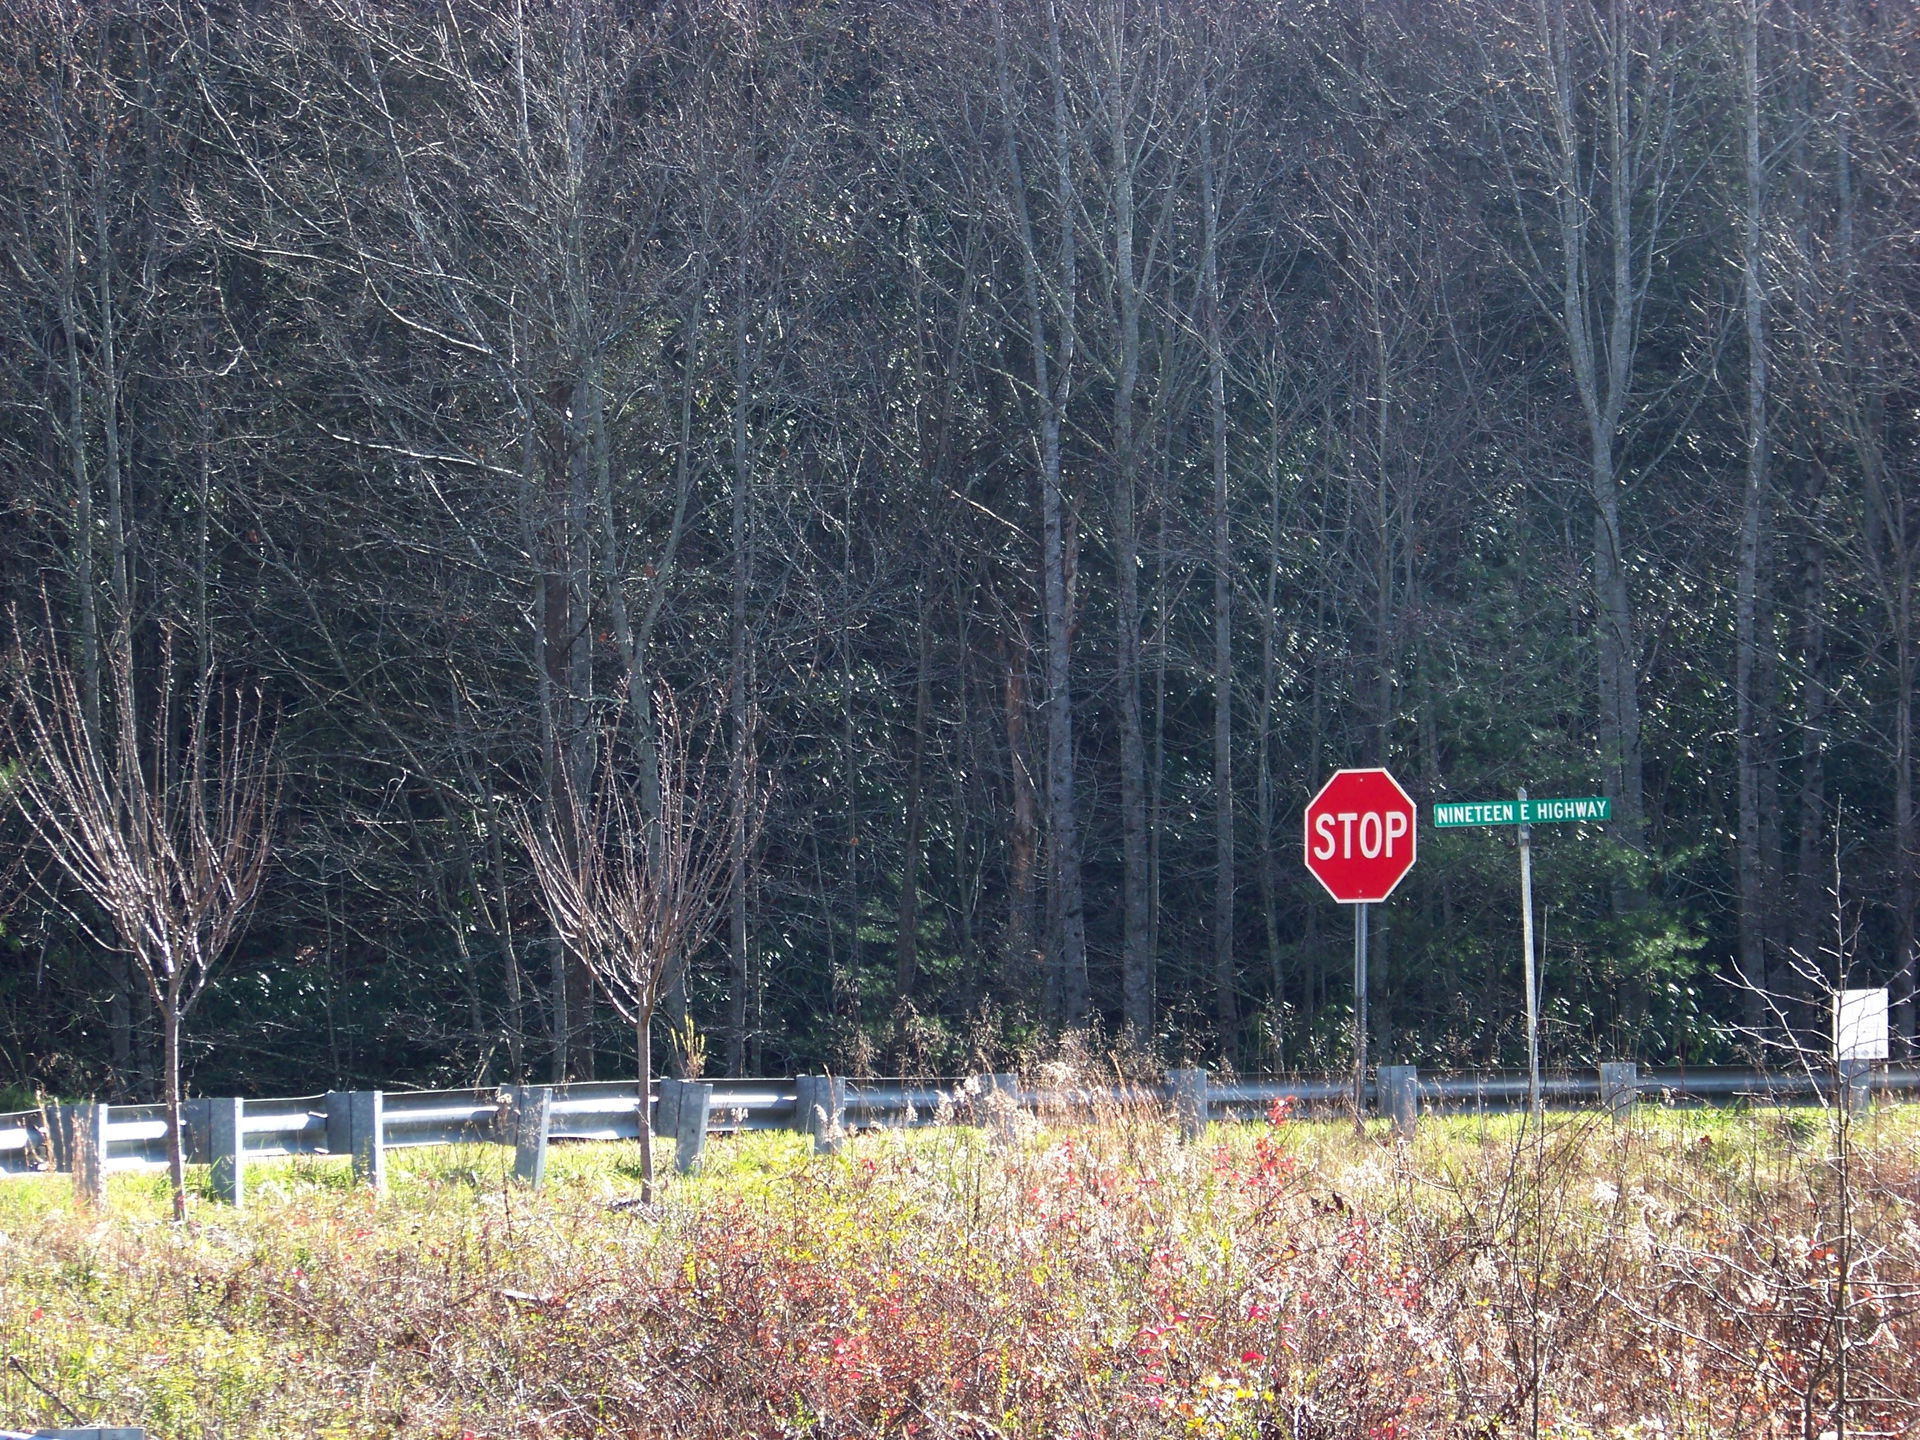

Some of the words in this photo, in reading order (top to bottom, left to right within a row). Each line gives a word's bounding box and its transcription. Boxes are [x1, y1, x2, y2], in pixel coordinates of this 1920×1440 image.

[1437, 805, 1513, 823] NINETEEN
[1520, 804, 1530, 820] E
[1537, 800, 1607, 819] HIGHWAY
[1314, 811, 1407, 860] STOP
